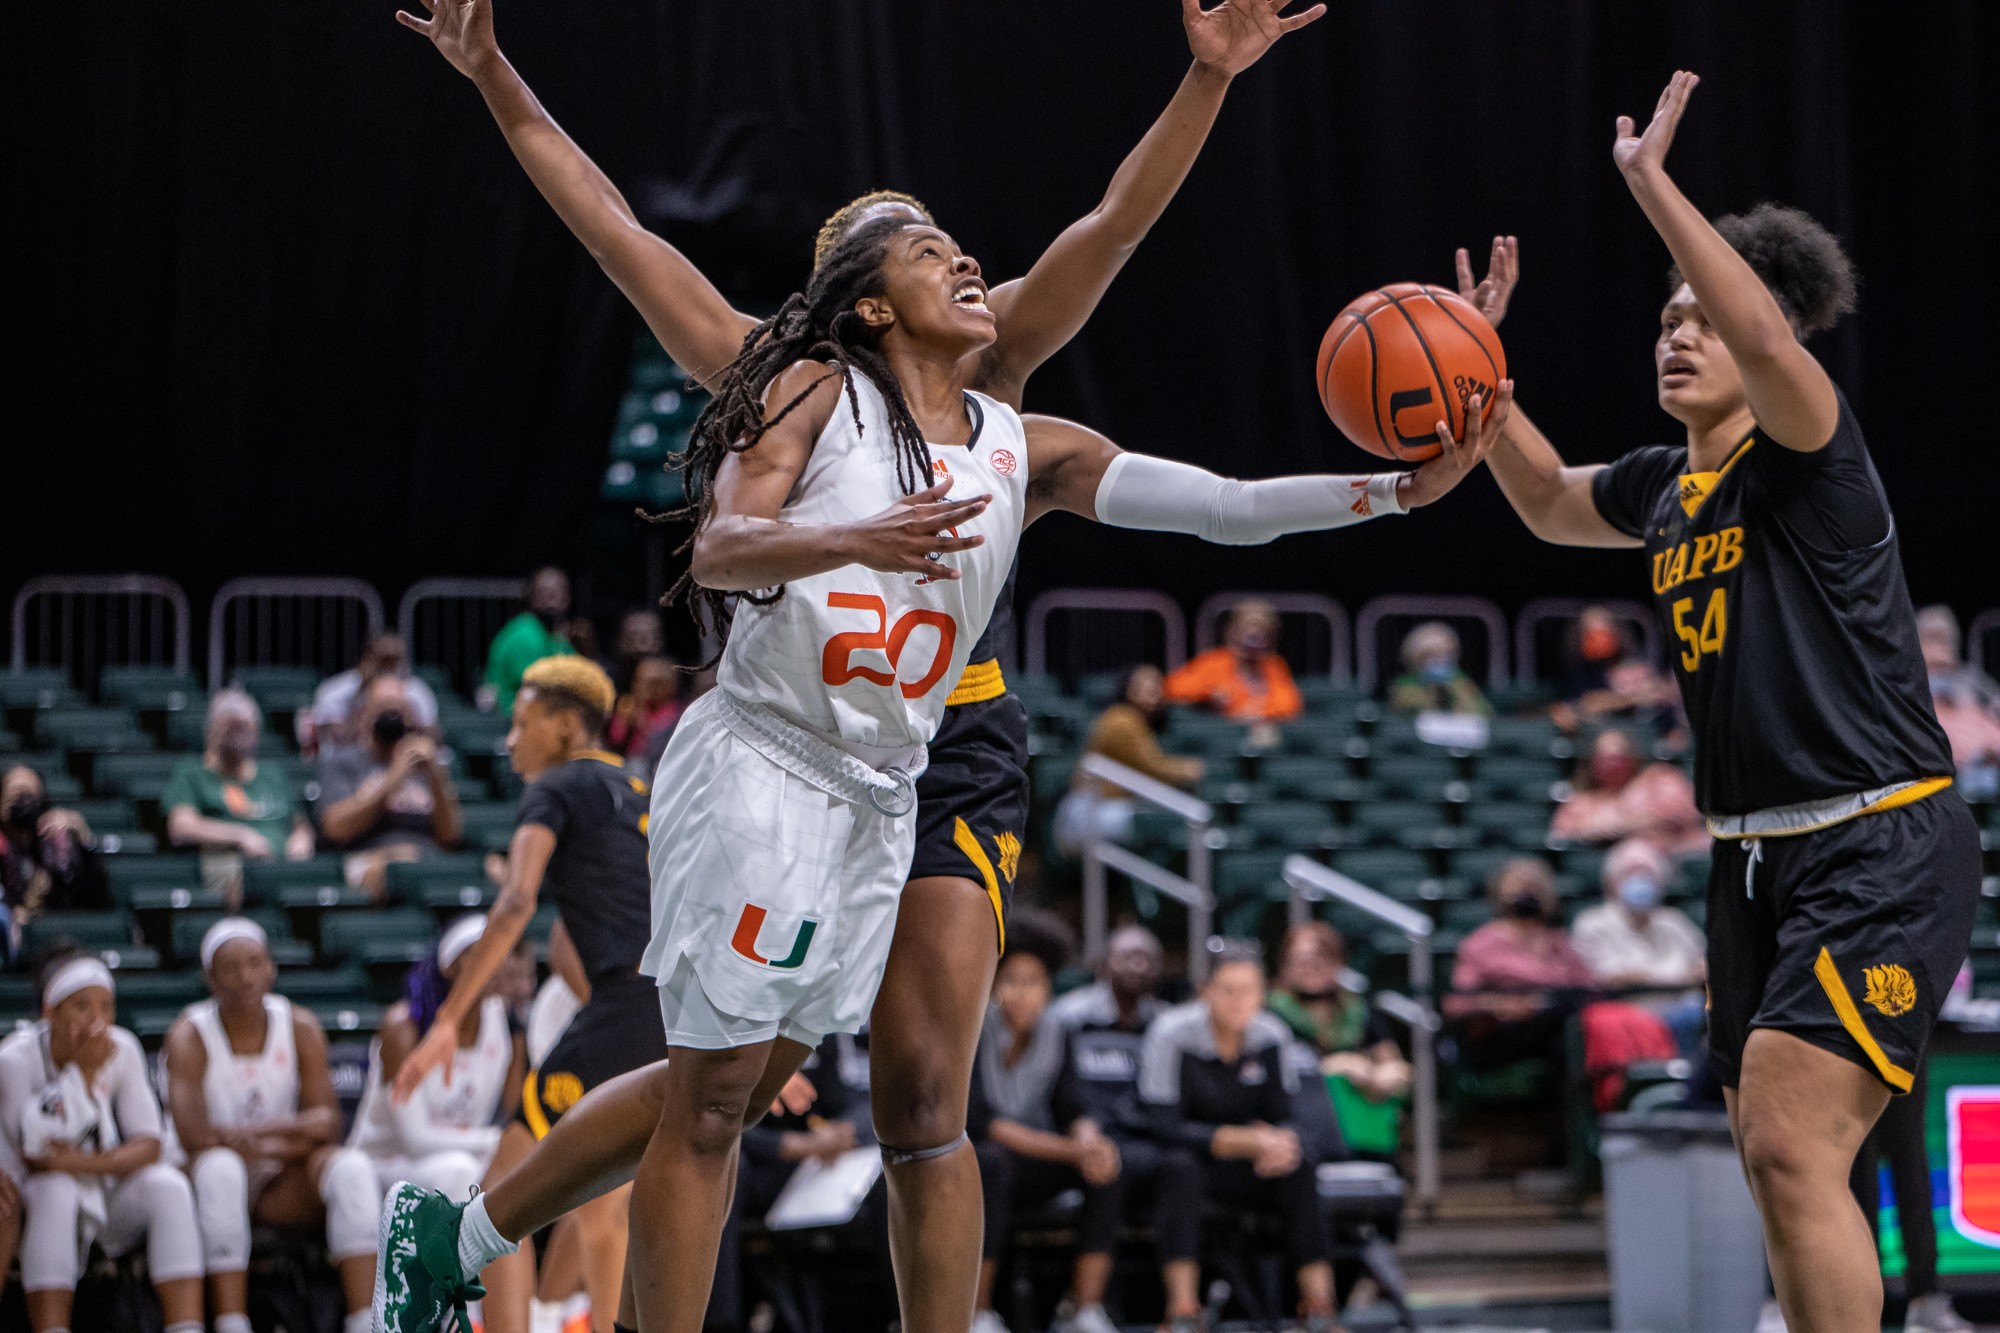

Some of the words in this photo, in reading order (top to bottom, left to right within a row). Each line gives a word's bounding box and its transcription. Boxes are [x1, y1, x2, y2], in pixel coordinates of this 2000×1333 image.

[1653, 526, 1745, 595] UAPB
[822, 592, 957, 699] 20
[1672, 587, 1727, 672] 54
[730, 901, 819, 970] U
